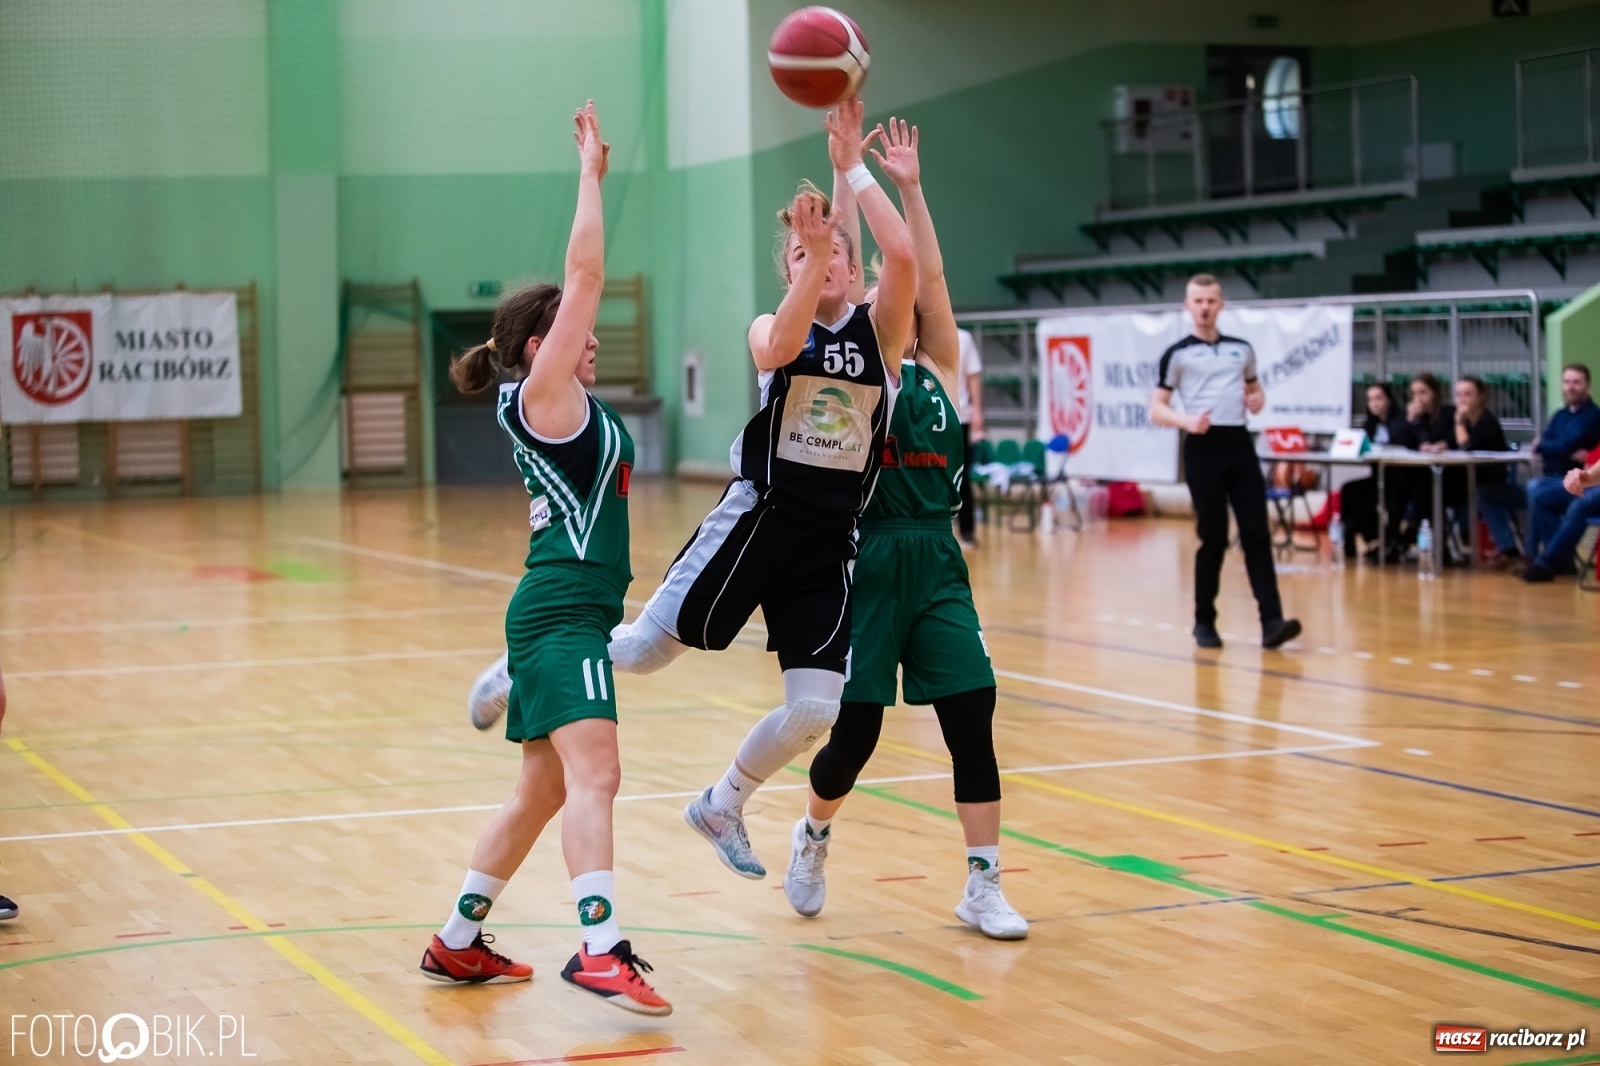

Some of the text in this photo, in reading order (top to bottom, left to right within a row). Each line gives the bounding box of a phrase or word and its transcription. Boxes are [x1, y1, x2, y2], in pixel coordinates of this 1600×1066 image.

[114, 328, 214, 352] MIASTO
[99, 355, 232, 384] RACIBÓRZ
[823, 341, 865, 377] 55
[931, 396, 947, 432] 3
[789, 432, 863, 454] BE COMPLEAT
[582, 657, 608, 701] 11
